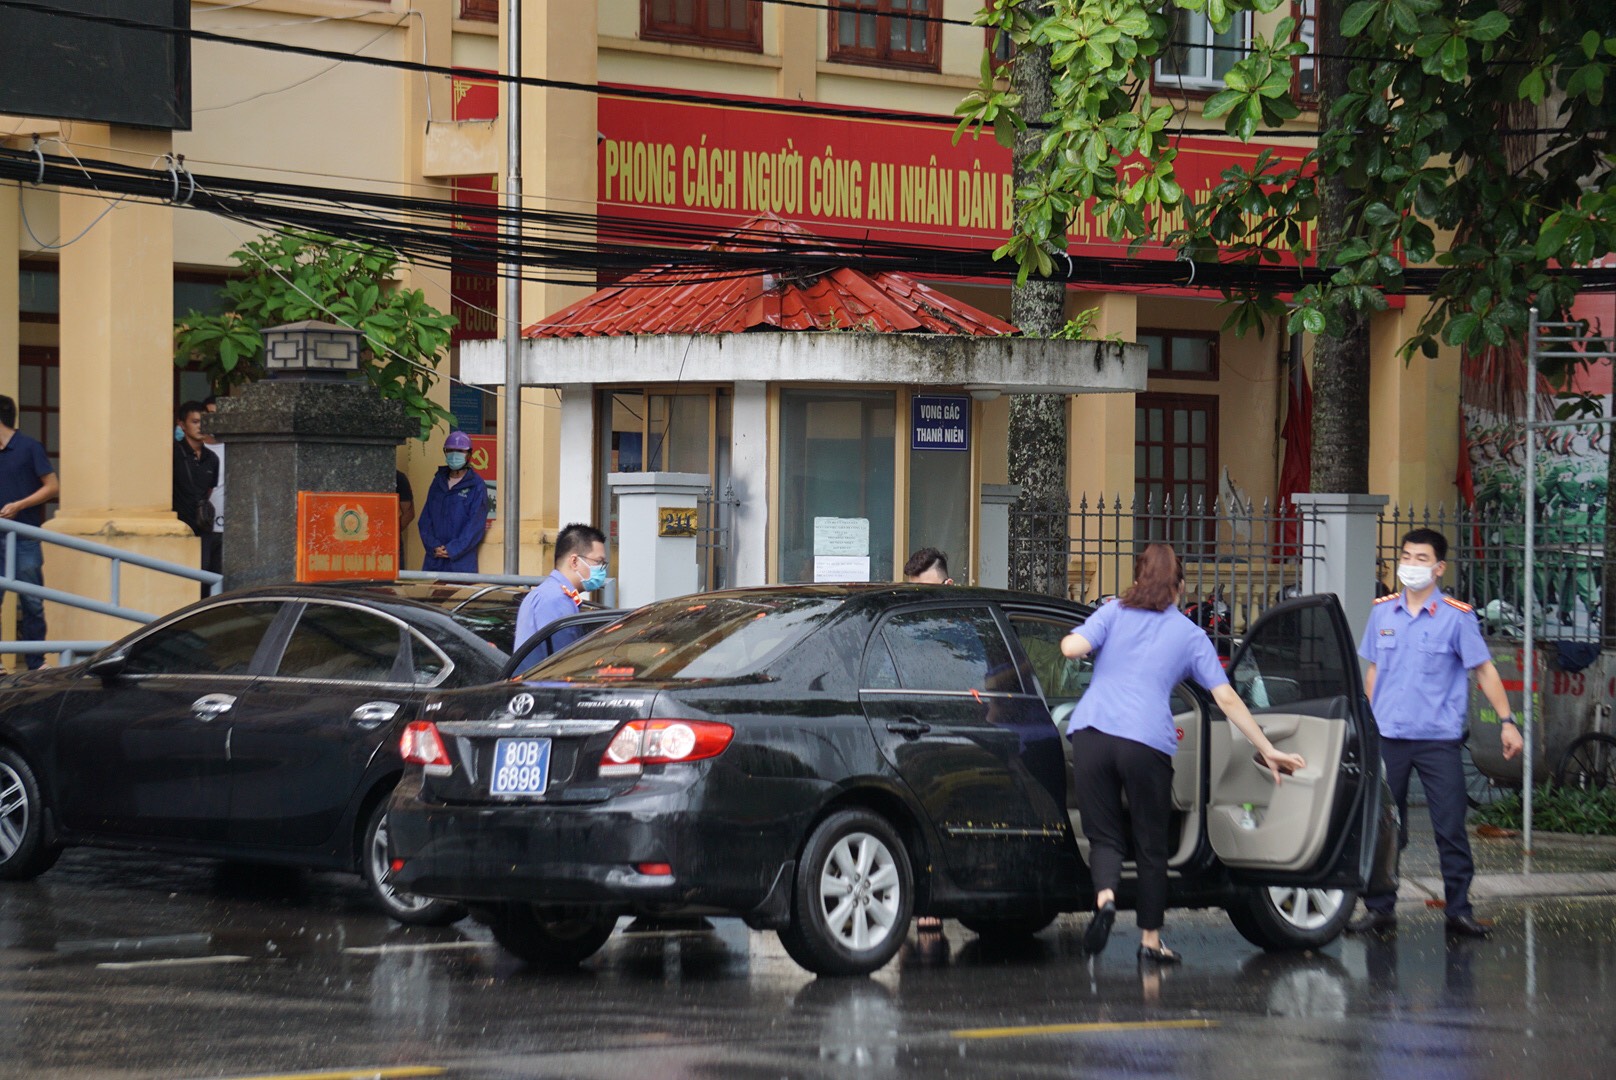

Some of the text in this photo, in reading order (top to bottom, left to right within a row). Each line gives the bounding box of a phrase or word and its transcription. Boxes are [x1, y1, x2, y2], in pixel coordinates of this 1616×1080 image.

[606, 139, 676, 205] PHONG
[682, 134, 737, 209] CÁCH
[743, 138, 804, 214] NGƯỜI
[810, 145, 862, 219] CÔNG
[867, 162, 894, 221] AN
[901, 155, 952, 226] NHÂN
[959, 158, 996, 229] DÂN
[921, 403, 960, 421] VỌNG GÁC
[917, 426, 964, 443] THANH NIÊN
[506, 741, 539, 766] 80B
[497, 766, 541, 791] 6898
